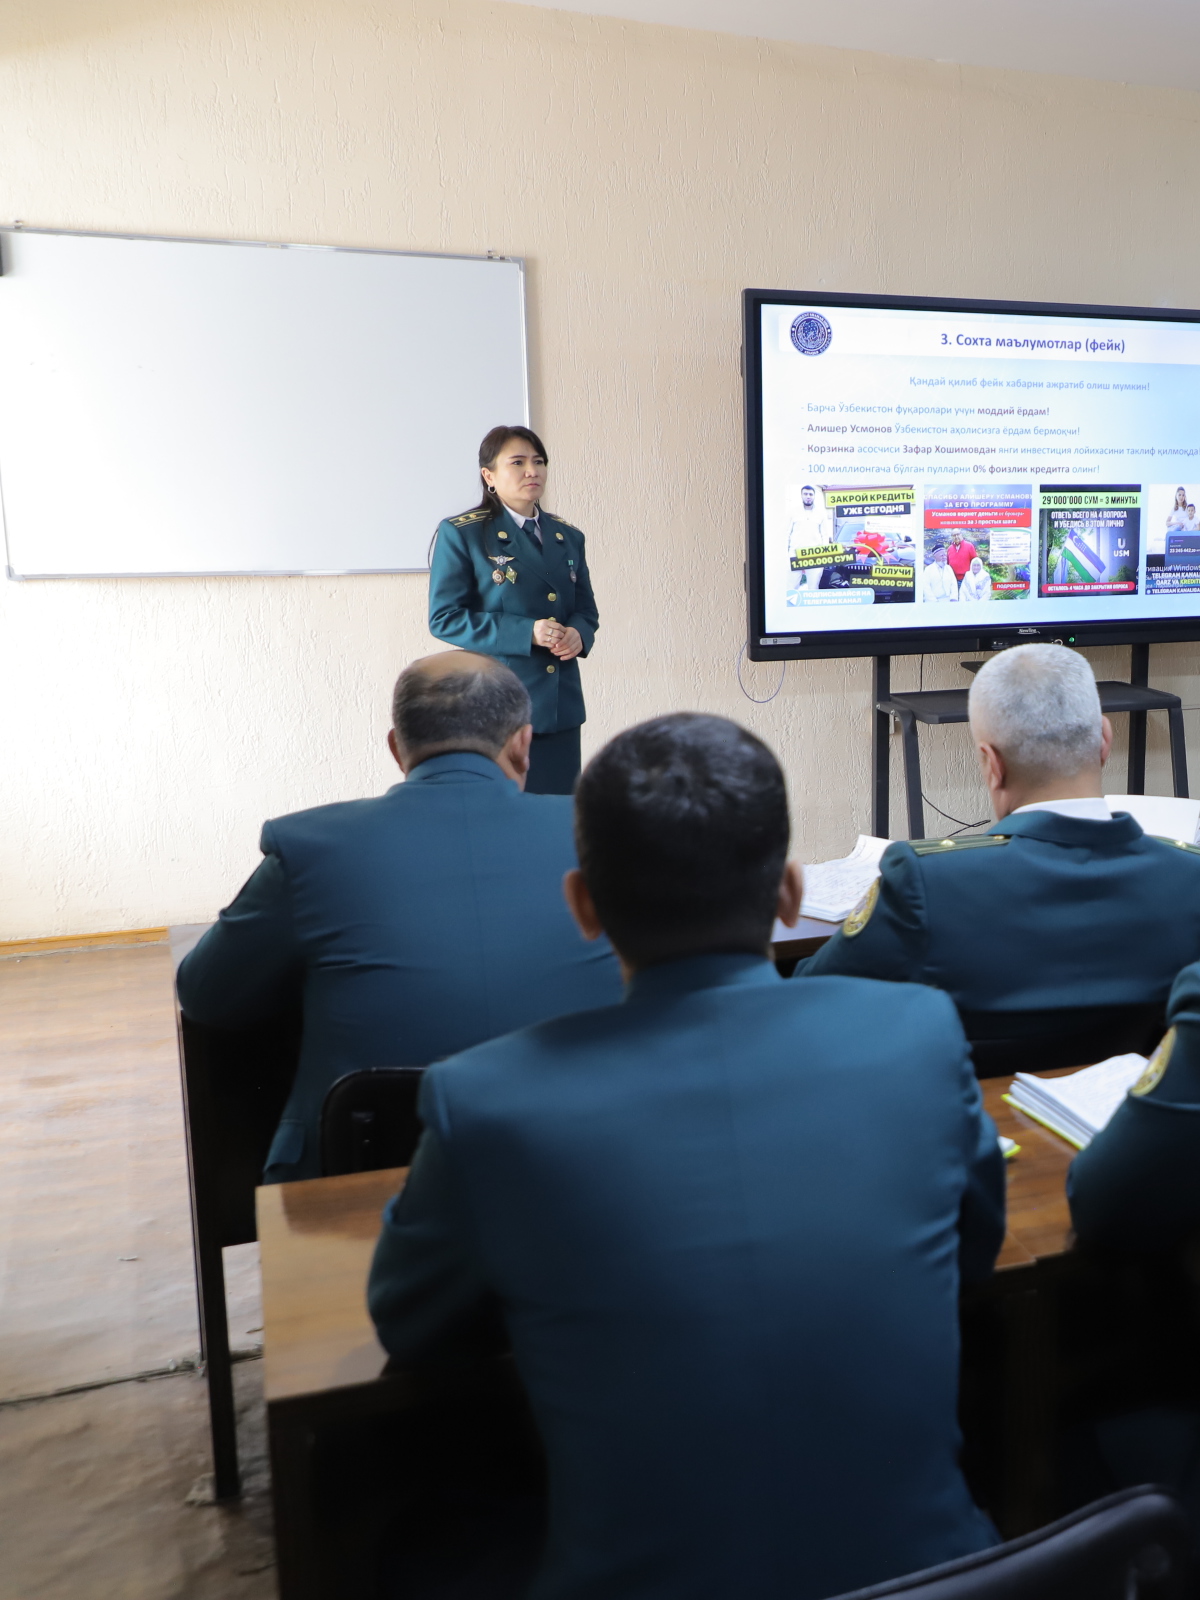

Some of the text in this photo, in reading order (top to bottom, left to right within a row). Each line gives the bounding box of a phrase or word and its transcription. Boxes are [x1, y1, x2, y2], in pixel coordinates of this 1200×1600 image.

[940, 333, 1126, 354] 3. Сохта маълумотлар (фейк)
[909, 376, 1150, 392] Қандай қилиб фейк хабарни ажратиб олиш мумкин!
[807, 402, 1050, 417] Барча Ўзбекистон фуқаролари учун моддий ёрдам!
[807, 423, 1080, 437] Алишер Усмонов Ўзбекистон аҳолисизга ёрдам бермоқчи!
[807, 444, 855, 455] Корзинка
[857, 446, 900, 454] асосчиси
[902, 444, 932, 455] Зафар
[934, 445, 996, 455] Хошимовдан
[1020, 446, 1072, 455] инвестиция
[1126, 446, 1156, 456] таклиф
[808, 463, 1100, 475] 100 миллионгача бўлган пулларни 0% фоизлик кредитга олинг!
[830, 492, 914, 503] ЗАКРОЙ КРЕДИТЫ
[1084, 495, 1099, 504] СУМ
[1105, 496, 1109, 504] 3
[1110, 495, 1138, 505] МИНУТЫ
[843, 505, 905, 515] УЖЕ СЕГОДНЯ
[1051, 511, 1072, 519] ОТВЕТЬ
[1072, 511, 1090, 519] ВСЕГО
[1103, 510, 1127, 518] ВОПРОСА
[1059, 520, 1084, 528] УБЕДИСЬ
[800, 545, 838, 556] ВЛОЖИ
[791, 554, 854, 568] 1.100.000 СУМ
[874, 567, 911, 576] ПОЛУЧИ
[851, 578, 913, 588] 25.000.000 СУМ
